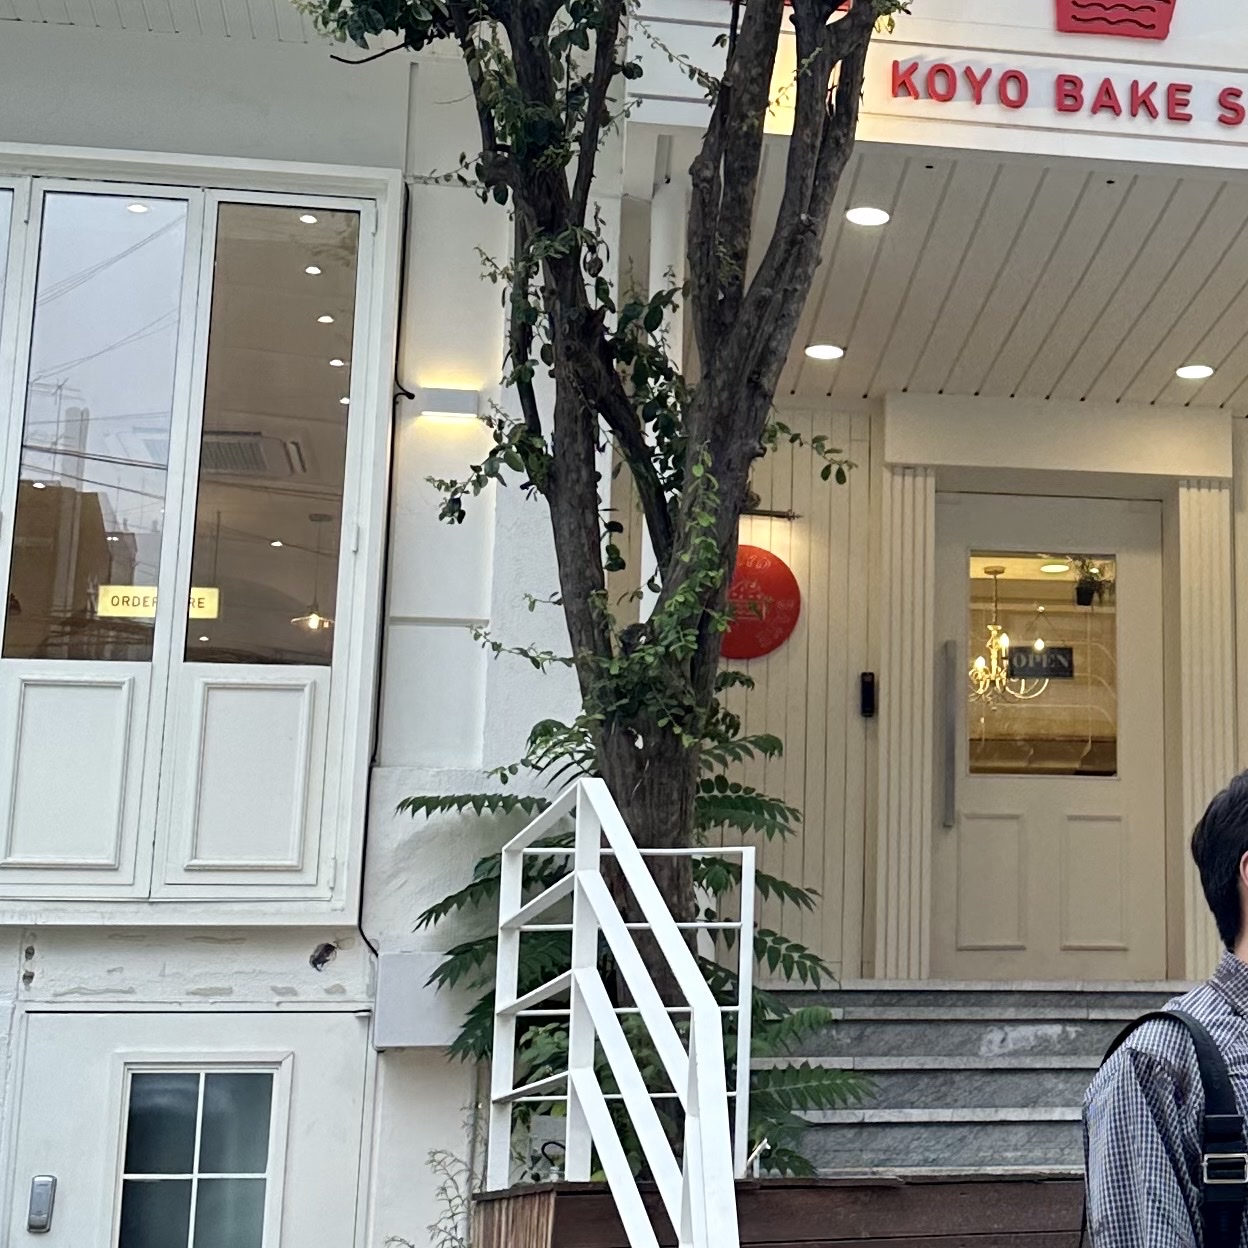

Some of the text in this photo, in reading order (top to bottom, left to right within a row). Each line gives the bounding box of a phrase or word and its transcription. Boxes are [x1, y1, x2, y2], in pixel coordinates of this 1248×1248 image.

[892, 60, 1029, 108] KOYO
[1055, 74, 1193, 122] BAKE
[1012, 653, 1069, 668] OPEN
